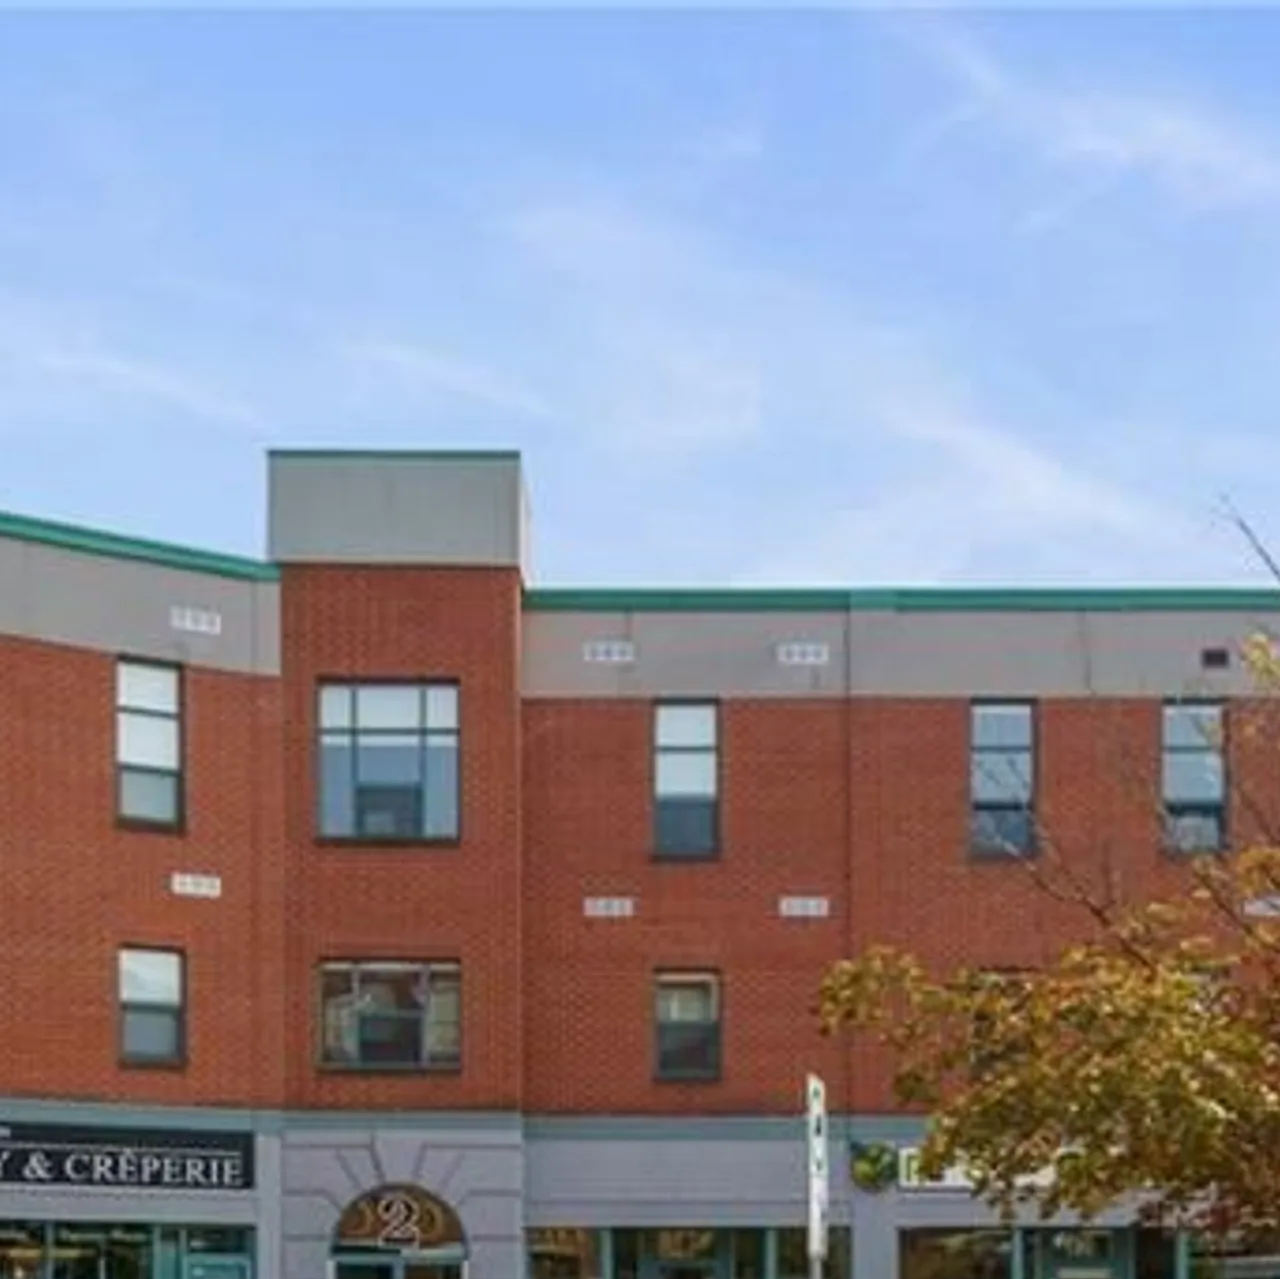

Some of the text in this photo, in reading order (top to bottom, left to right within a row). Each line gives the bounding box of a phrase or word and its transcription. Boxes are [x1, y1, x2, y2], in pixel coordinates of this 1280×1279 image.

[23, 1151, 53, 1180] &
[64, 1148, 243, 1187] CRÊPERIE
[378, 1193, 421, 1250] 2
